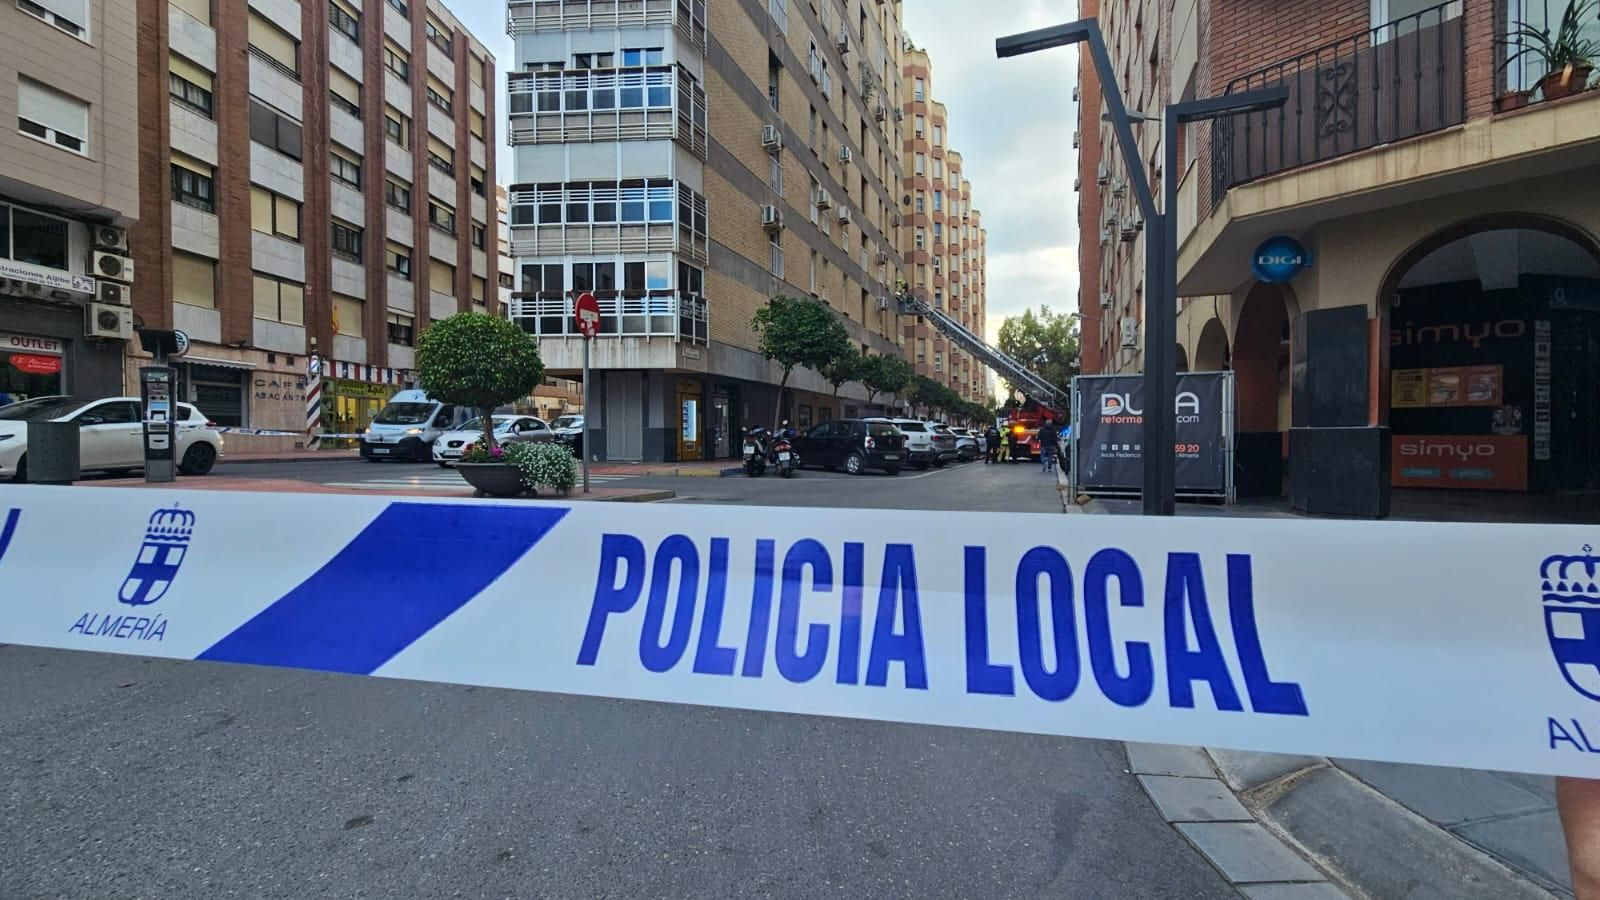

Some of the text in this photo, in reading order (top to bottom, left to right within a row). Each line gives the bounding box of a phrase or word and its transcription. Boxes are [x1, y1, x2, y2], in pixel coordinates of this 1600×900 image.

[1258, 255, 1302, 265] DIGI
[0, 265, 44, 279] traciones
[11, 336, 59, 350] OUTLET
[1400, 439, 1496, 462] simyo
[68, 612, 169, 642] ALMERÍA
[575, 532, 1310, 717] POLICIA LOCAL
